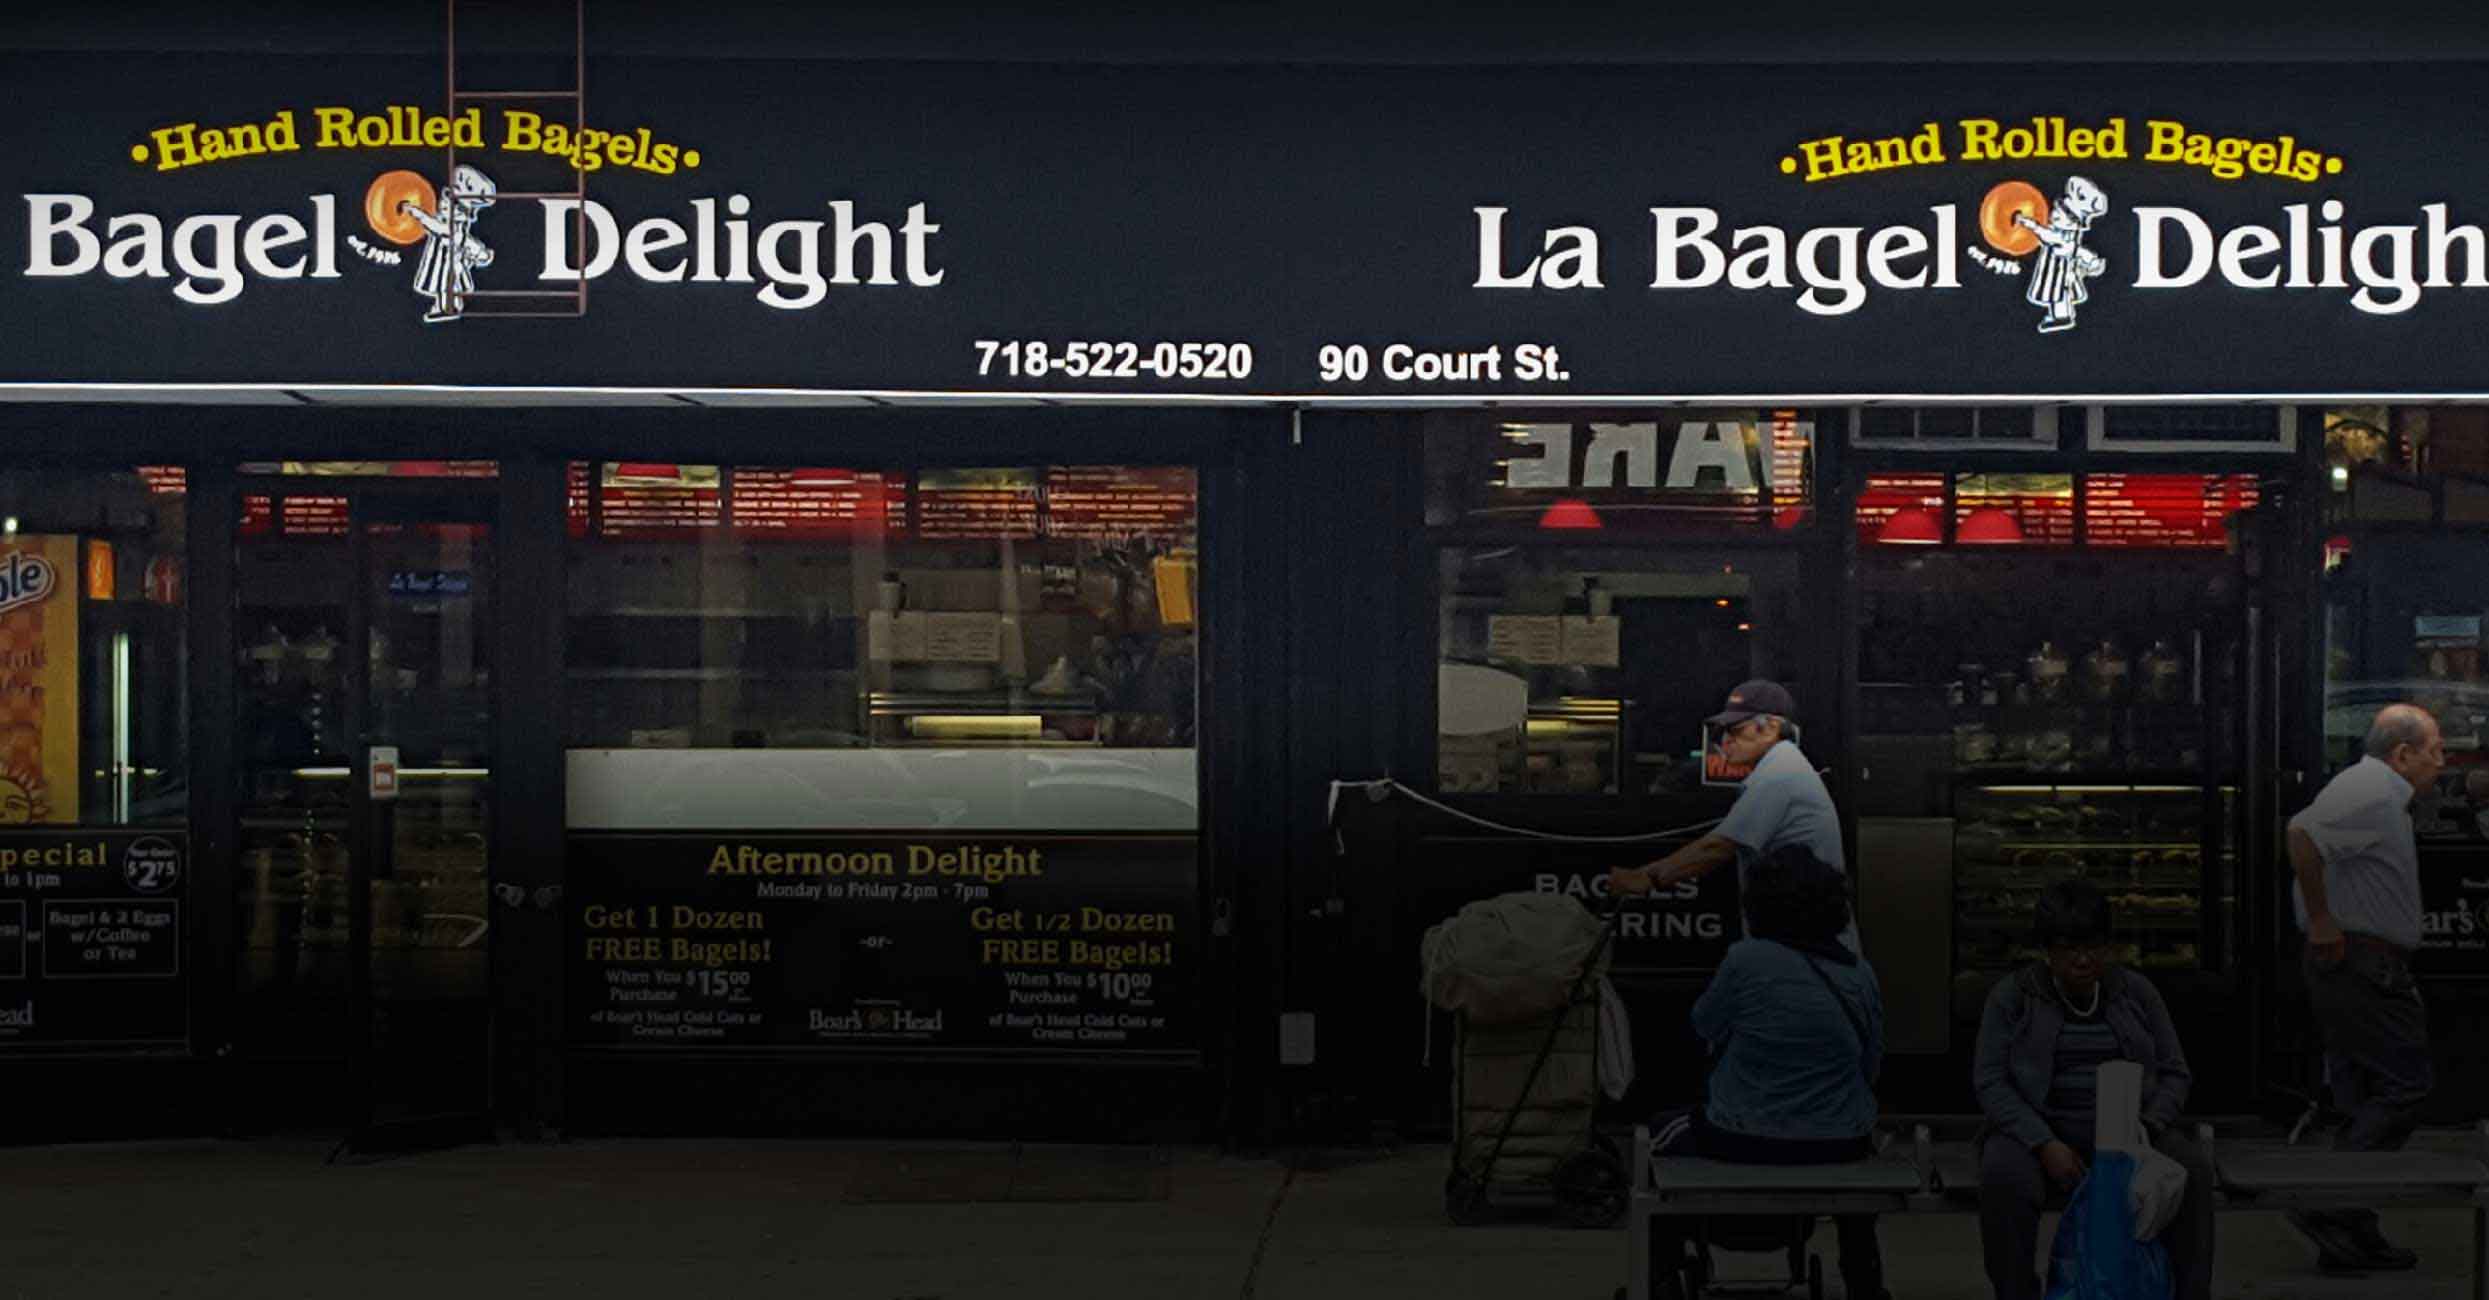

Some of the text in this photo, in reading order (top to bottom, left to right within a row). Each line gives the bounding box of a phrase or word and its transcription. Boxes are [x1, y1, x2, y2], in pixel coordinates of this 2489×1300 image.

[152, 106, 680, 176] Hand Rolled Bagels
[1799, 117, 2321, 182] Hand Rolled Bagels
[22, 193, 945, 310] Bagel Delight
[1473, 200, 2489, 316] La Bagel Deligh
[974, 341, 1253, 379] 718-522-0520
[1319, 343, 1570, 380] 90 Court St.
[706, 844, 1045, 882] Afternoon Delight
[757, 882, 821, 901] Monday
[827, 882, 843, 897] to
[848, 882, 898, 901] Friday
[901, 882, 938, 902] 2pm
[954, 882, 989, 902] 7pm
[583, 904, 765, 930] Get 1 Dozen
[969, 906, 1024, 931] Get
[1079, 905, 1176, 931] Dozen
[584, 937, 772, 967] FREE Bagels!
[982, 940, 1174, 971] FREE Bagels!
[1008, 989, 1078, 1004] Purchase
[893, 1008, 943, 1031] Head
